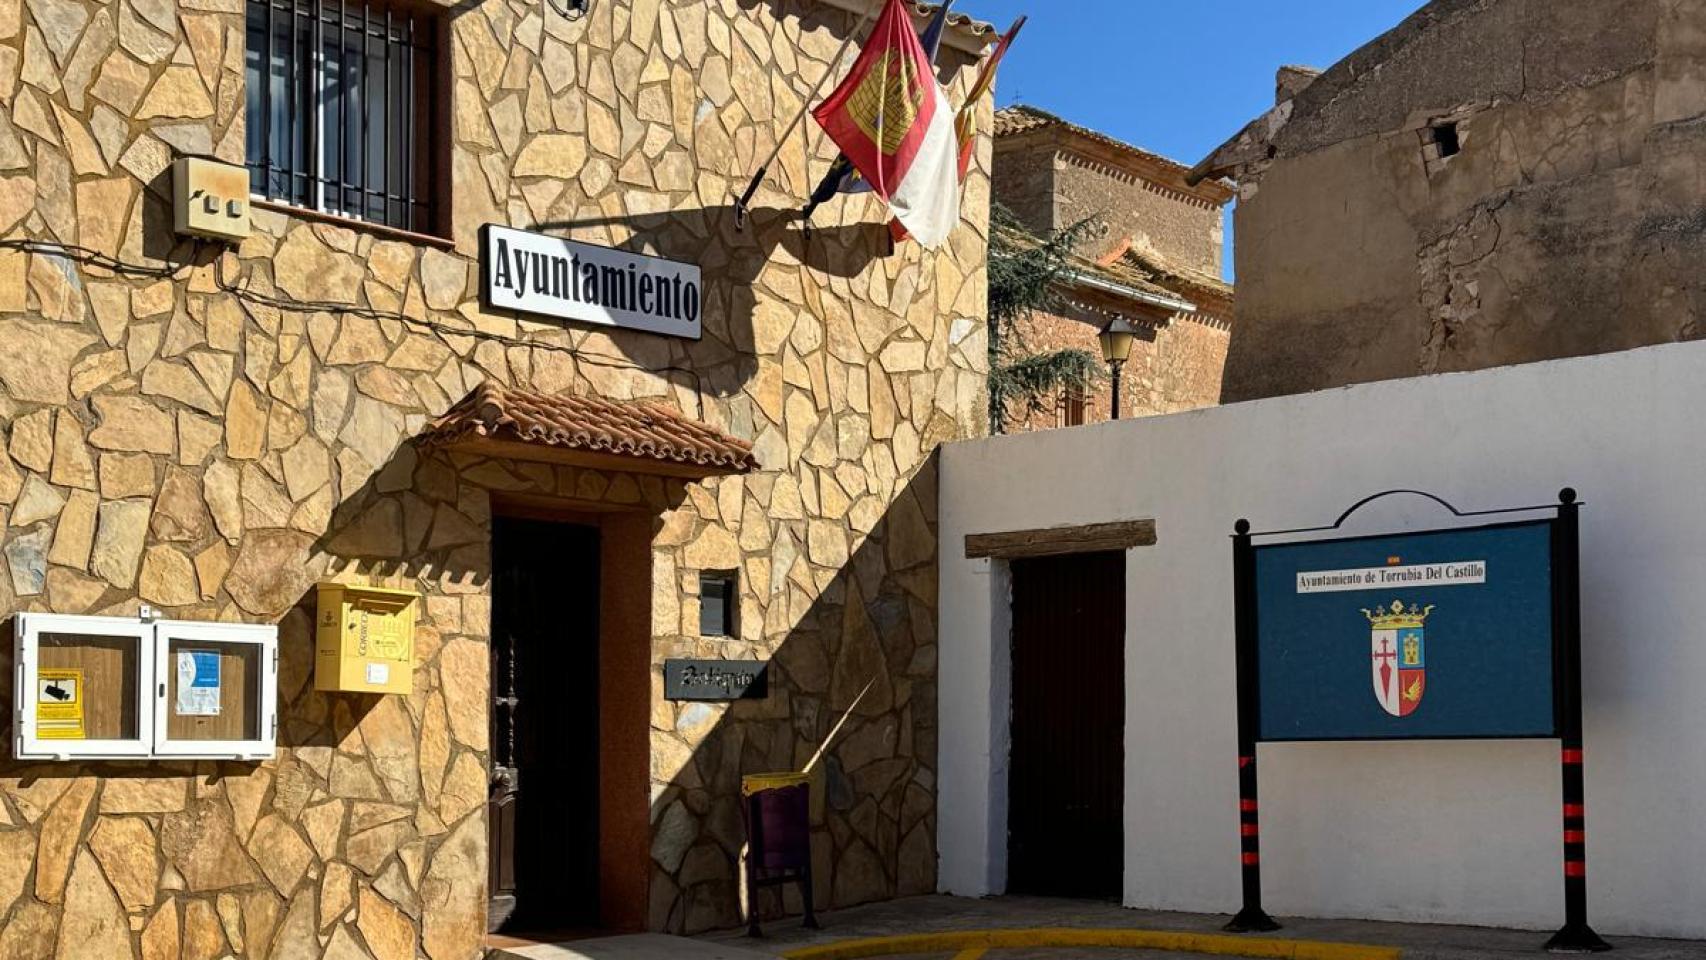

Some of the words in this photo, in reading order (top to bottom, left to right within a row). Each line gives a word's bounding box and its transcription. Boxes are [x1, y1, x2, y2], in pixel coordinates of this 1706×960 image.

[494, 238, 699, 322] Ayuntamiento
[1301, 571, 1361, 590] Ayuntamiento
[1364, 571, 1376, 583] de
[1379, 567, 1423, 583] Torrubia
[1426, 566, 1443, 580] Del
[1445, 563, 1484, 578] Castillo
